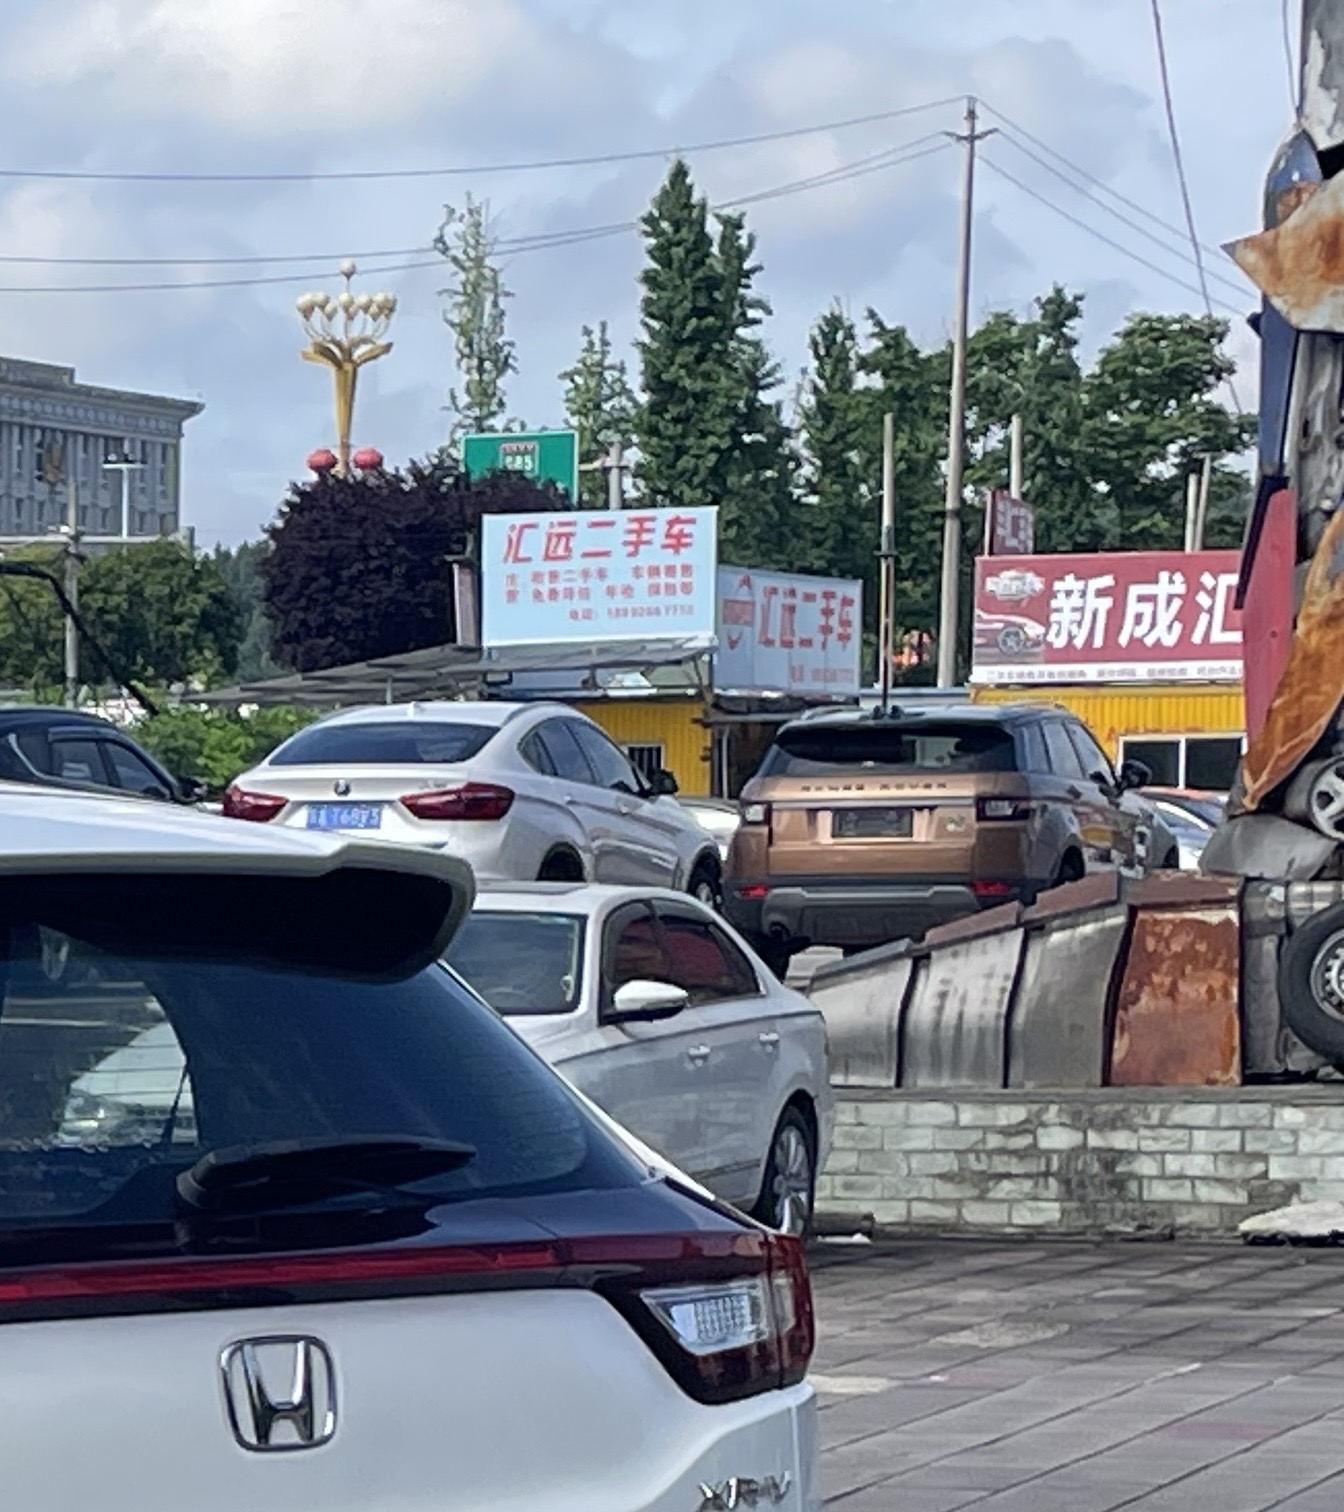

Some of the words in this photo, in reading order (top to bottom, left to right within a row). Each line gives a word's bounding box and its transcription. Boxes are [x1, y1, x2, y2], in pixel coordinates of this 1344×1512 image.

[503, 515, 697, 564] 汇远二手车
[1045, 570, 1244, 649] 新成汇
